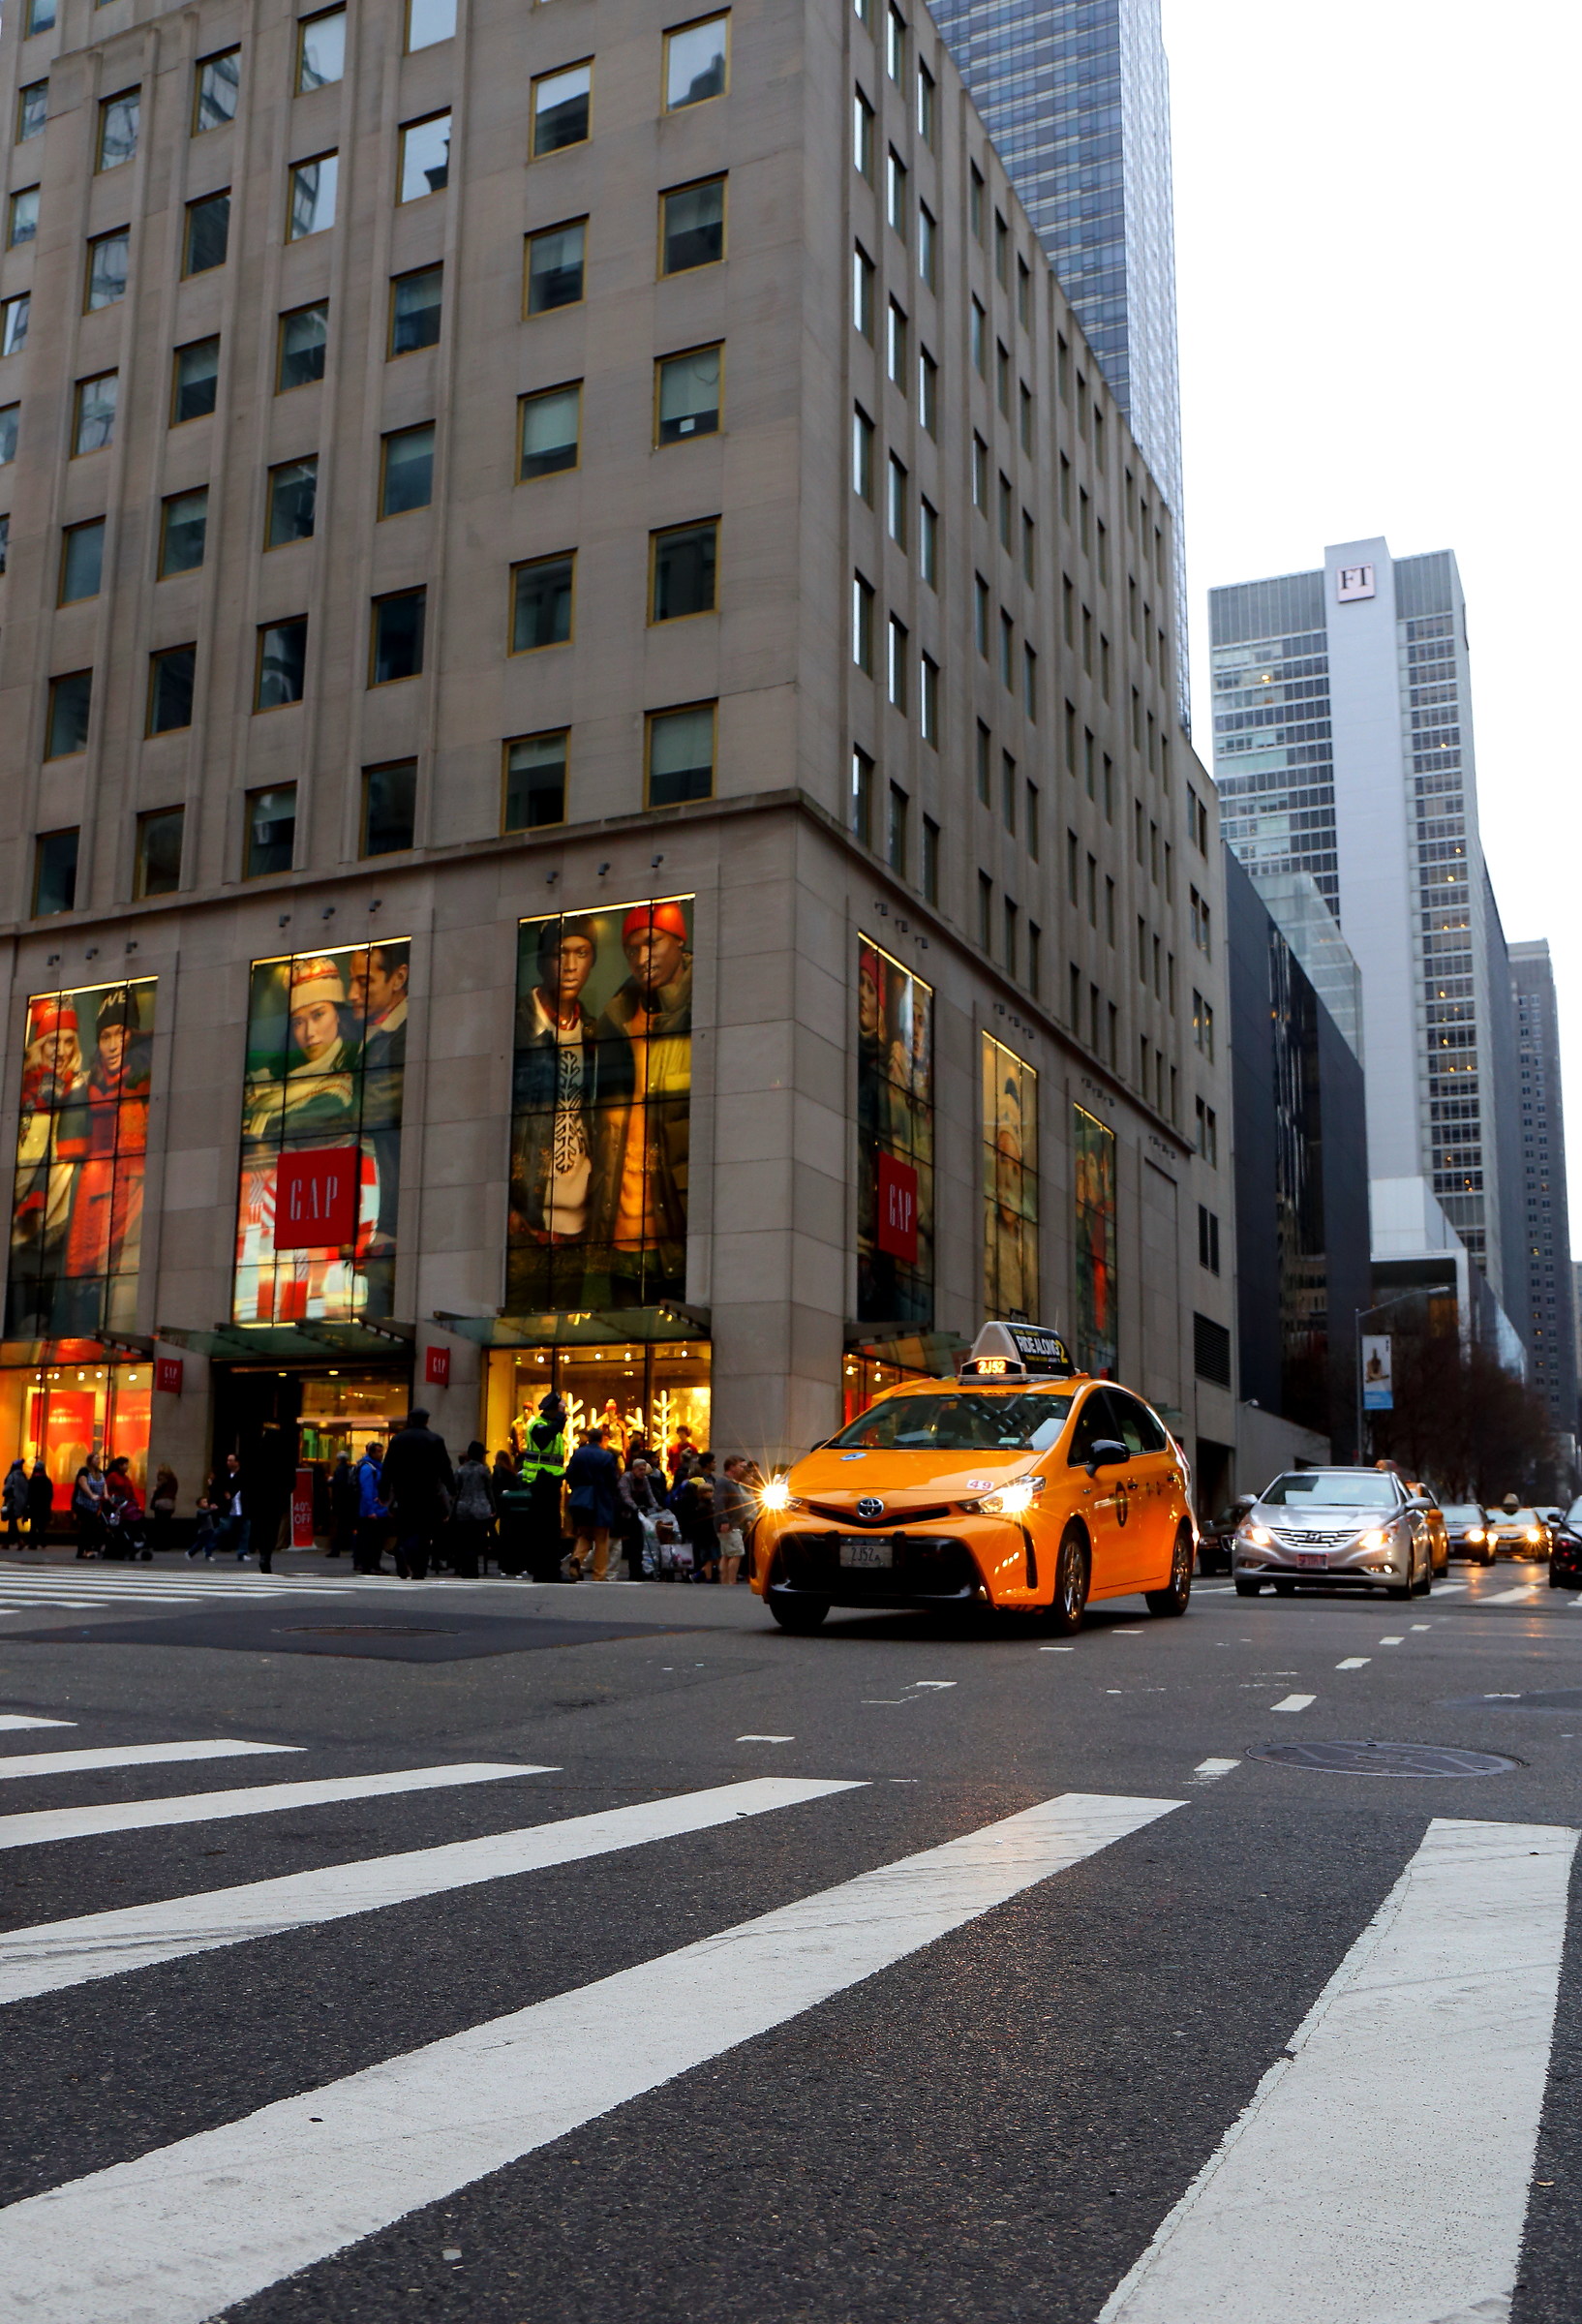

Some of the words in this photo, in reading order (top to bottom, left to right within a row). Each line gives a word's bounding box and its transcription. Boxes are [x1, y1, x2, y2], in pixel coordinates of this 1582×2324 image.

[1340, 566, 1371, 590] FT
[290, 1176, 337, 1221] GAP
[889, 1183, 912, 1233] GAP
[1016, 1334, 1037, 1354] RIDE
[1034, 1336, 1060, 1357] ALONG
[1054, 1338, 1068, 1363] 2
[165, 1365, 177, 1379] GAP
[433, 1357, 445, 1374] GAP
[978, 1361, 1006, 1374] 2J52
[969, 1481, 991, 1489] 49
[294, 1514, 312, 1525] OFF
